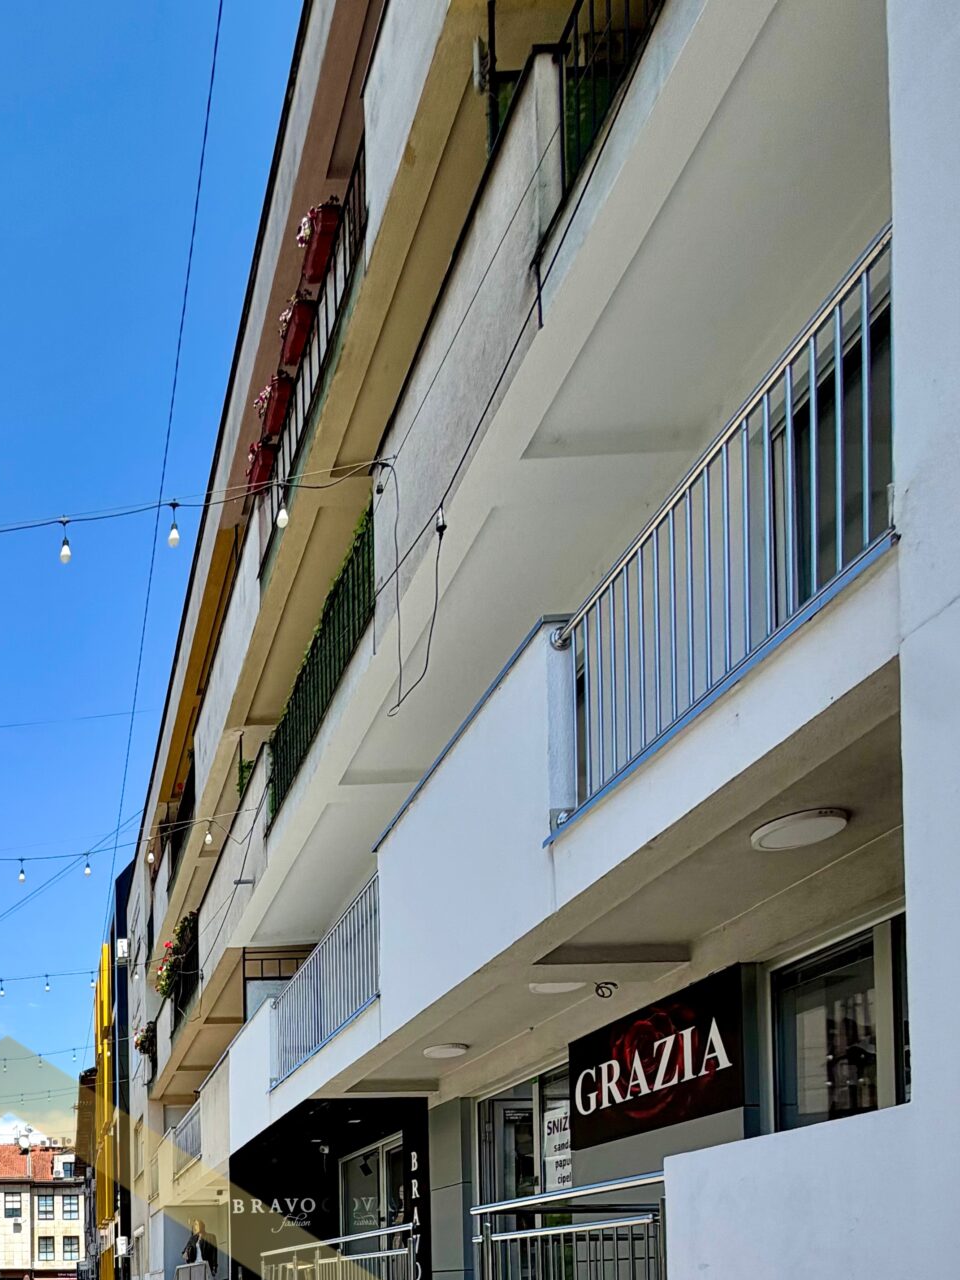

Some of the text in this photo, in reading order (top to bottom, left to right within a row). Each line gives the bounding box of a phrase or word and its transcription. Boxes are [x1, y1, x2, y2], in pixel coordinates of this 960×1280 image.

[575, 1016, 733, 1116] GRAZIA
[553, 1139, 570, 1152] sand
[233, 1198, 316, 1214] BRAVO
[271, 1212, 311, 1233] fashion
